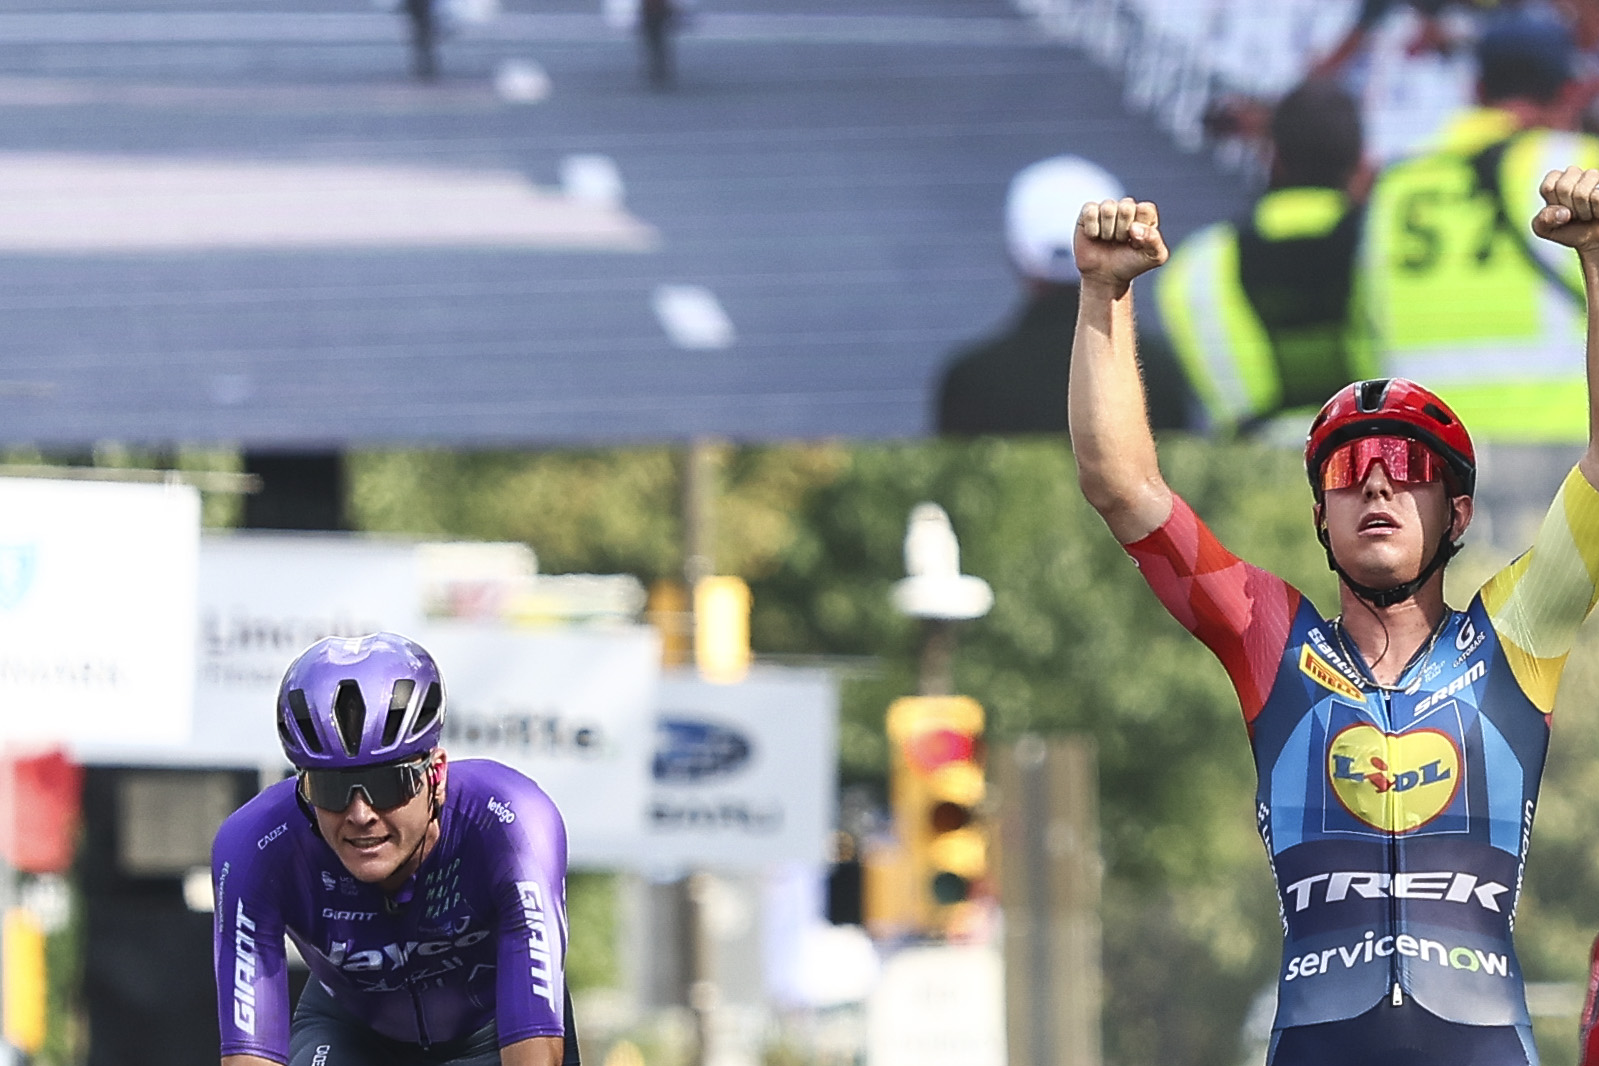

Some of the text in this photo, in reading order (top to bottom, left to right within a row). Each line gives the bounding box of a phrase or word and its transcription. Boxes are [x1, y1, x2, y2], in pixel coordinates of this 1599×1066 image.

[1307, 628, 1366, 689] Santini
[1453, 631, 1486, 668] GATORADE
[1414, 660, 1485, 717] SRAM
[257, 822, 289, 850] CADEX
[322, 908, 378, 920] GIANT
[1286, 872, 1510, 913] TREK
[233, 896, 257, 1037] GIANT
[515, 880, 556, 1014] GIANT
[1285, 930, 1509, 982] servicenow
